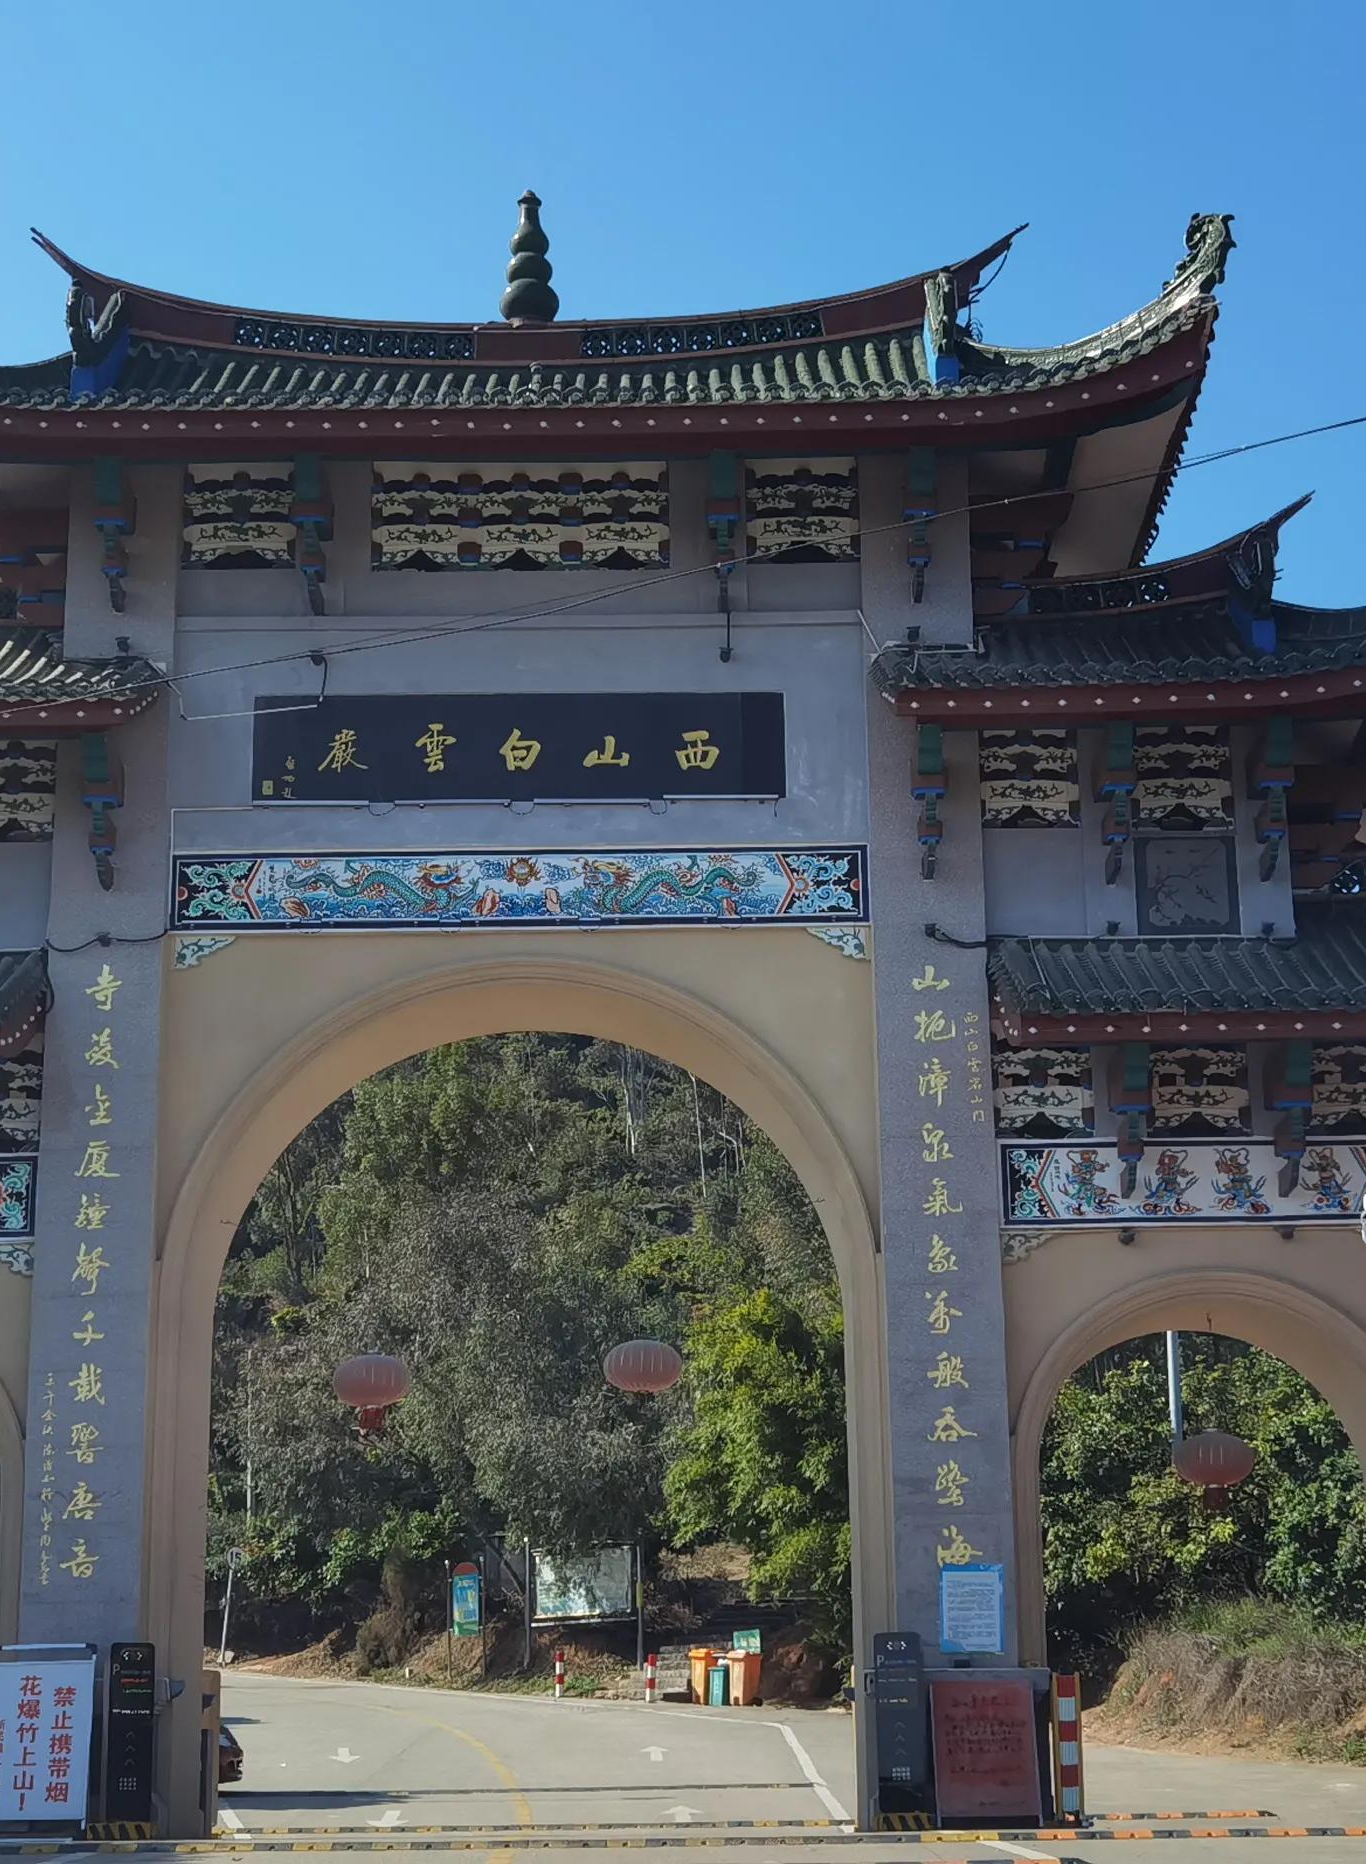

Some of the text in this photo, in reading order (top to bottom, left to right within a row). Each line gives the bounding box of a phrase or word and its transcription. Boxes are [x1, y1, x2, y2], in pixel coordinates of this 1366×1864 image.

[45, 1686, 76, 1803] 禁止携带烟
